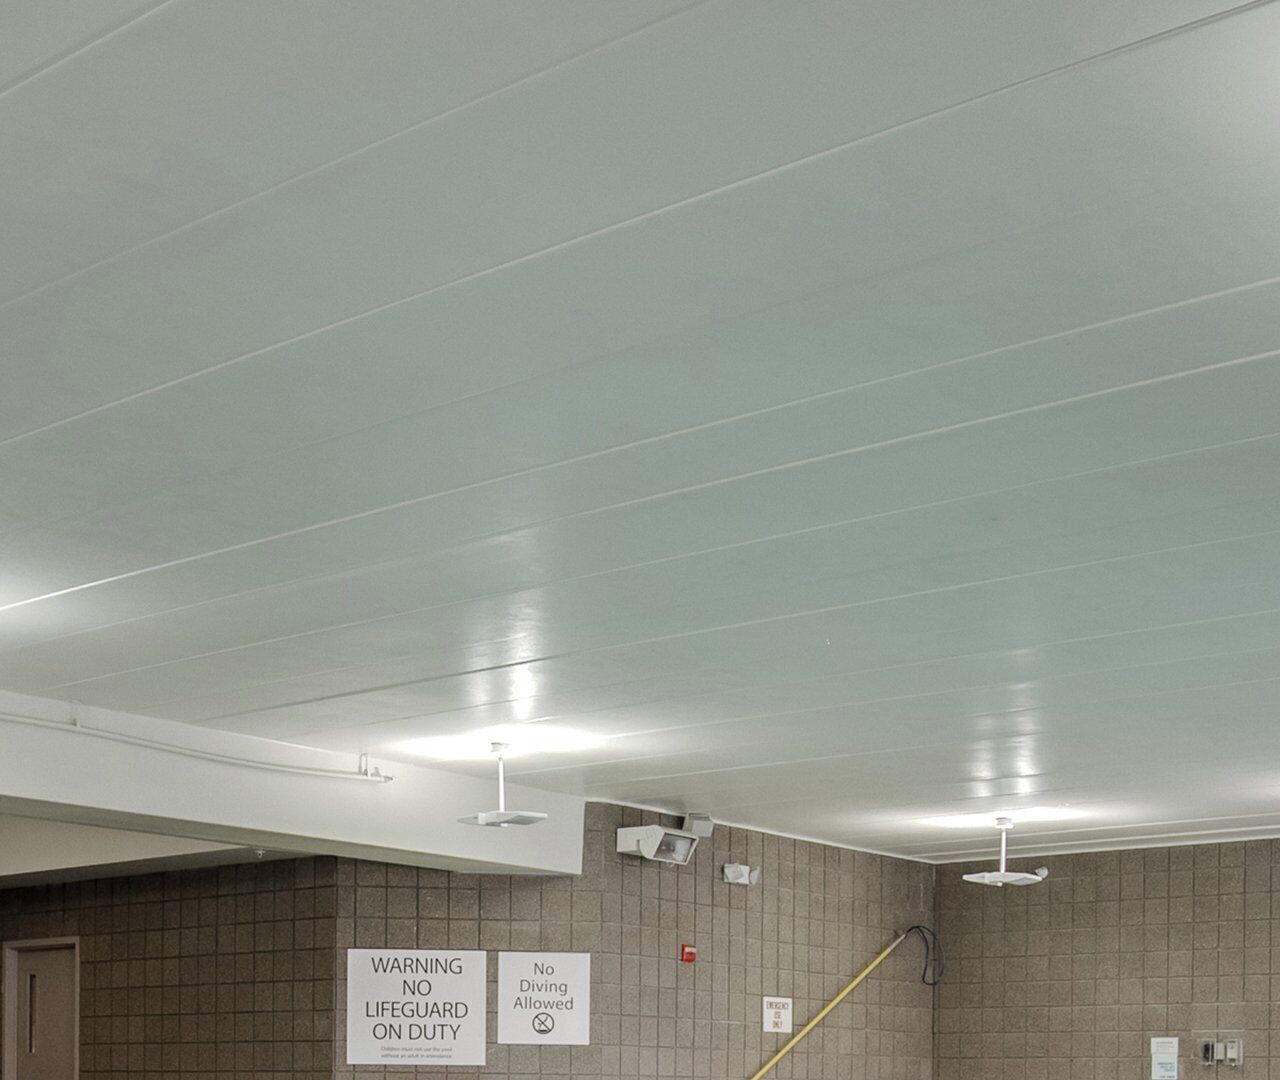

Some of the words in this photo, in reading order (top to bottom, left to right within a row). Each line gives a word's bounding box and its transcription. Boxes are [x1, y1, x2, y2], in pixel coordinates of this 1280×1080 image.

[371, 957, 463, 975] WARNING
[533, 963, 555, 976] No
[402, 979, 432, 996] NO
[519, 979, 568, 996] Diving
[365, 1001, 469, 1019] LIFEGUARD
[513, 996, 574, 1010] Allowed
[372, 1023, 402, 1040] ON
[409, 1023, 461, 1040] DUTY
